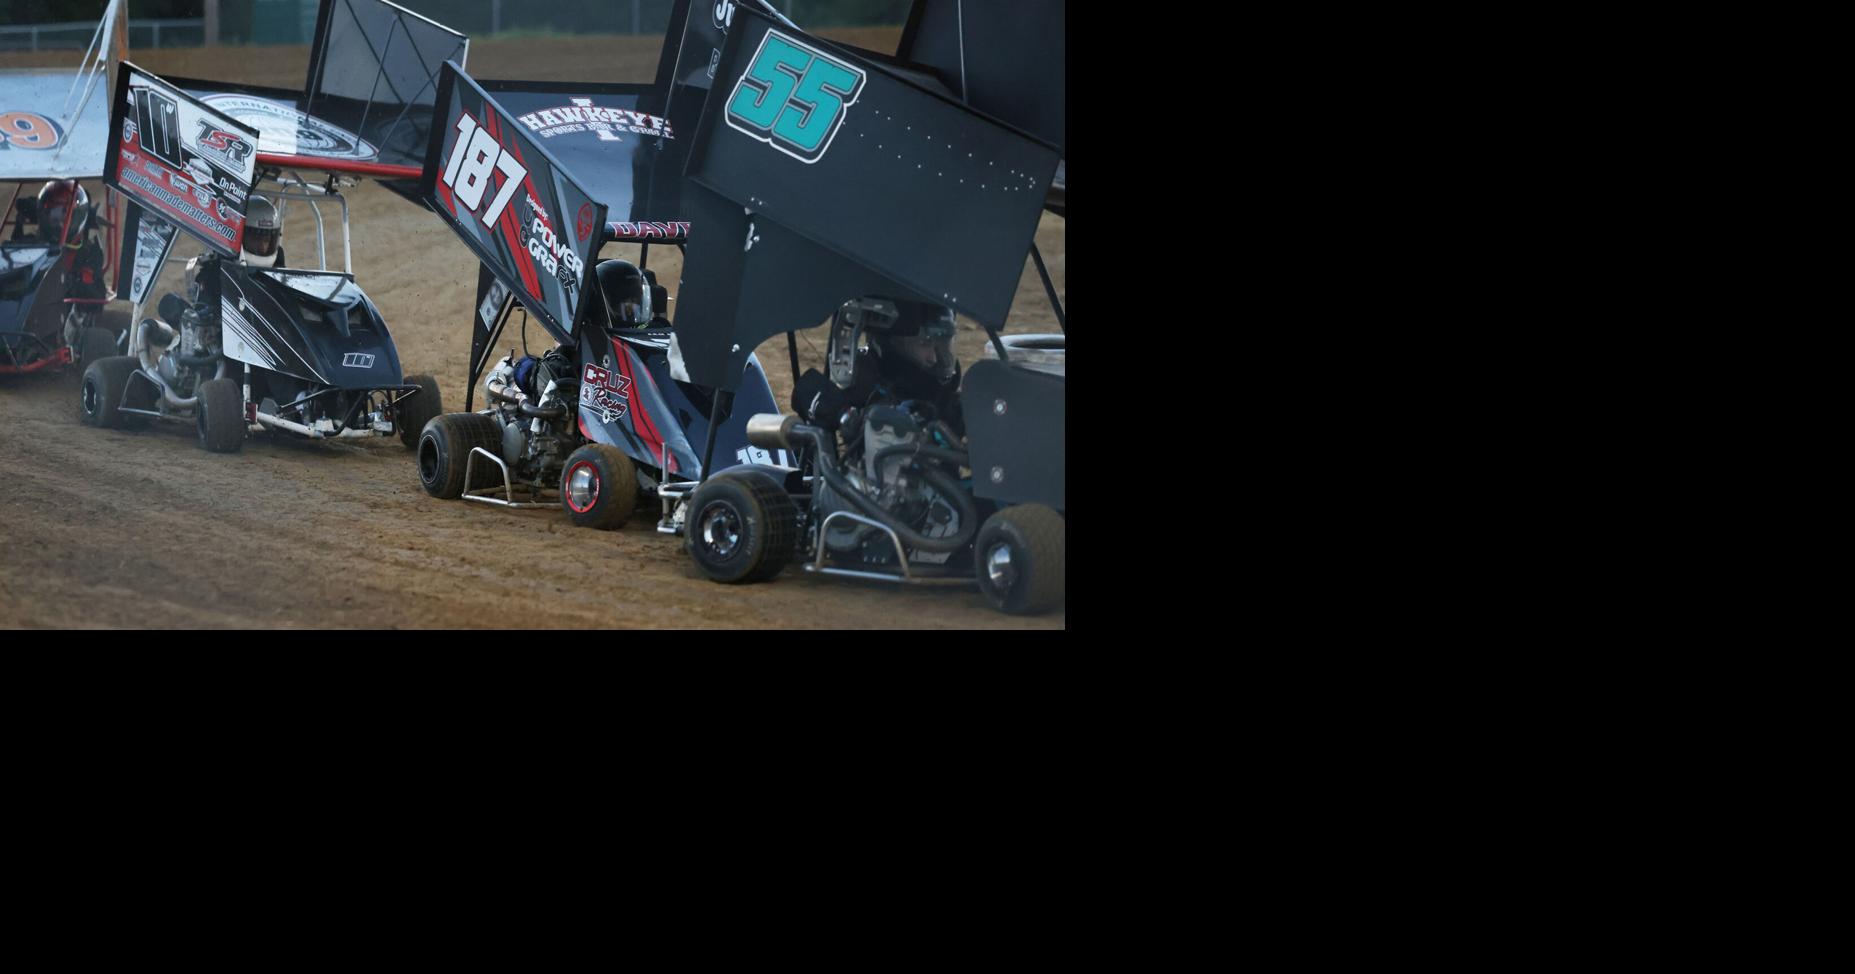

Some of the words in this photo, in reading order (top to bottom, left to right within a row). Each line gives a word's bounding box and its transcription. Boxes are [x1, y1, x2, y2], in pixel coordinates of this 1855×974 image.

[726, 29, 865, 163] 55
[517, 105, 673, 132] HAWKEYE
[539, 123, 586, 138] SPORTS
[196, 117, 253, 165] TSR
[219, 177, 230, 191] On
[229, 183, 248, 200] Point
[442, 112, 528, 231] 187
[121, 167, 237, 242] americanmadematters.com
[532, 217, 584, 278] POWER
[584, 363, 631, 399] CRUZ
[592, 386, 628, 420] Racing
